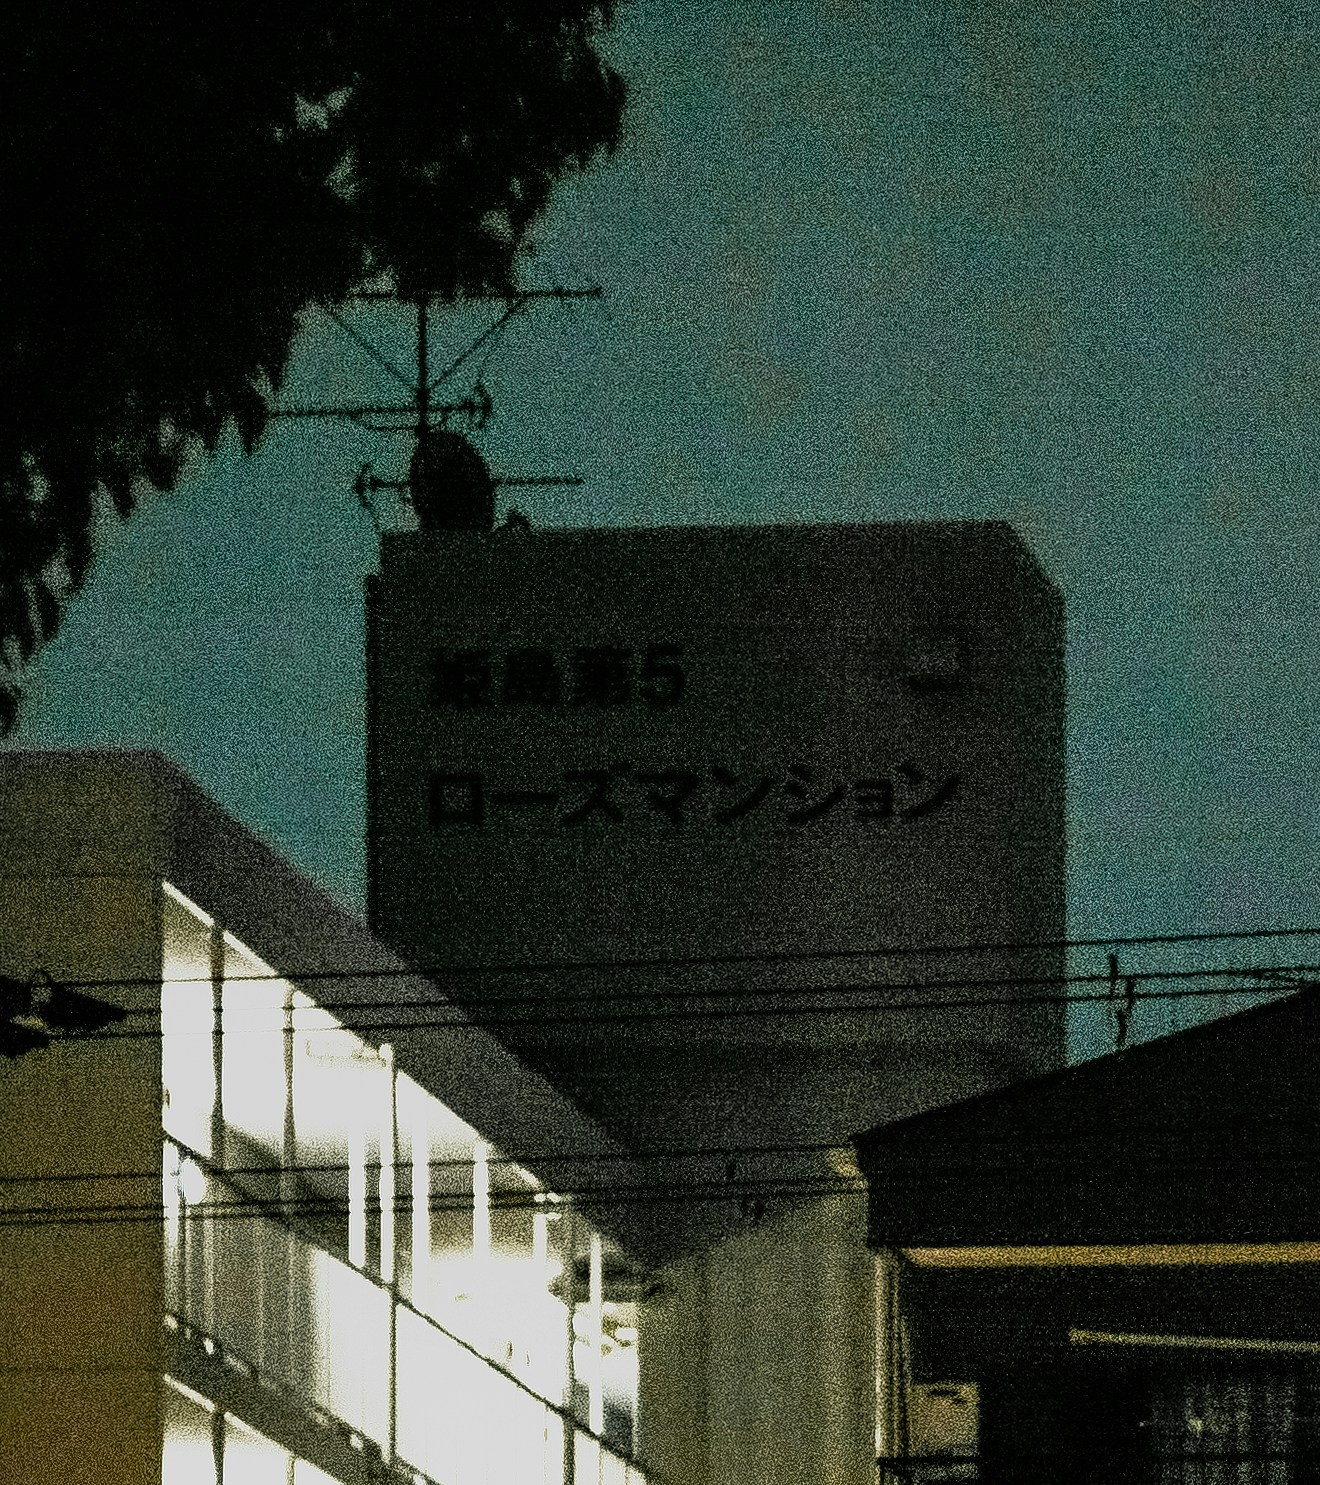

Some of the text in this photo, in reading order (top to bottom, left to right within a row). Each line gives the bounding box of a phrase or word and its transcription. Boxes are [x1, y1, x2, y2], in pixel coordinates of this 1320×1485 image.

[429, 762, 961, 826] ローズマンション
